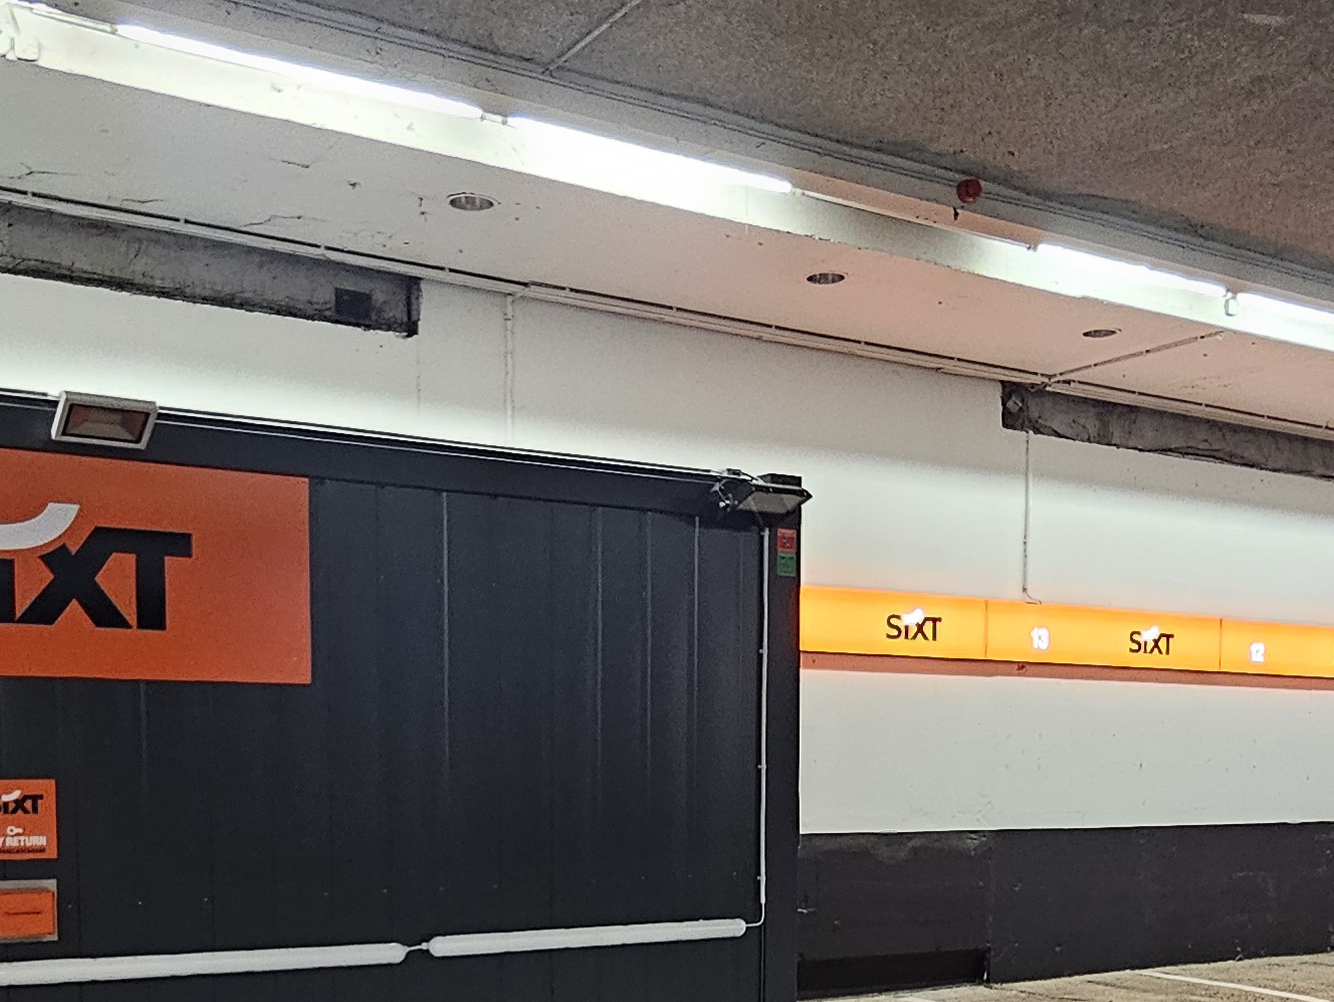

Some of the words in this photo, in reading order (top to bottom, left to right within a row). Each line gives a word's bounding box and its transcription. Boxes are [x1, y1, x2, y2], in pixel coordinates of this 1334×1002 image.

[885, 608, 942, 642] SIXT
[1030, 626, 1050, 650] 13
[1128, 625, 1175, 656] SIXT
[1249, 641, 1266, 663] 12
[5, 835, 47, 847] RETURN
